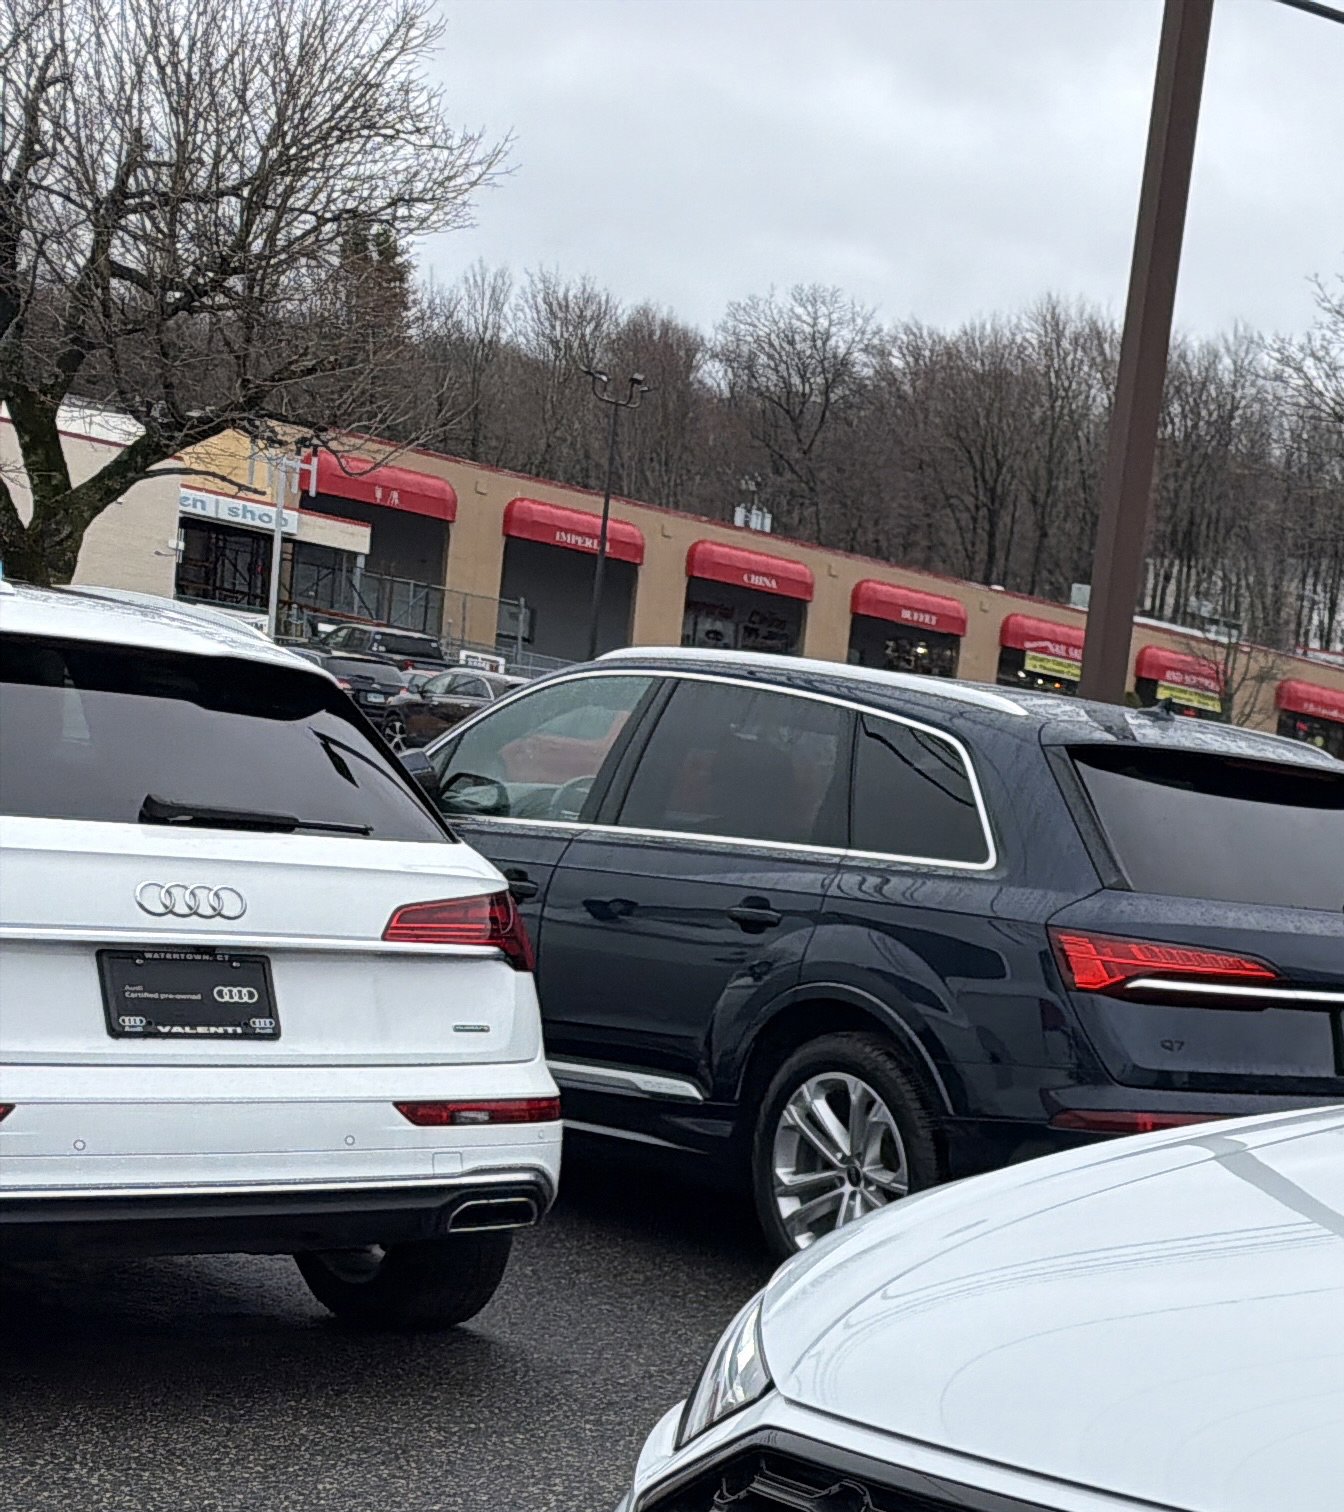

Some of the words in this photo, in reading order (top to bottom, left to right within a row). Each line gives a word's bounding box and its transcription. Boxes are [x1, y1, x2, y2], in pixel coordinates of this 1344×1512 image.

[180, 495, 207, 511] en
[555, 531, 610, 552] IMPERIL
[743, 573, 778, 589] CHINA
[125, 991, 159, 1000] Certified
[156, 1025, 243, 1034] VALENTI
[1161, 1039, 1185, 1052] Q7
